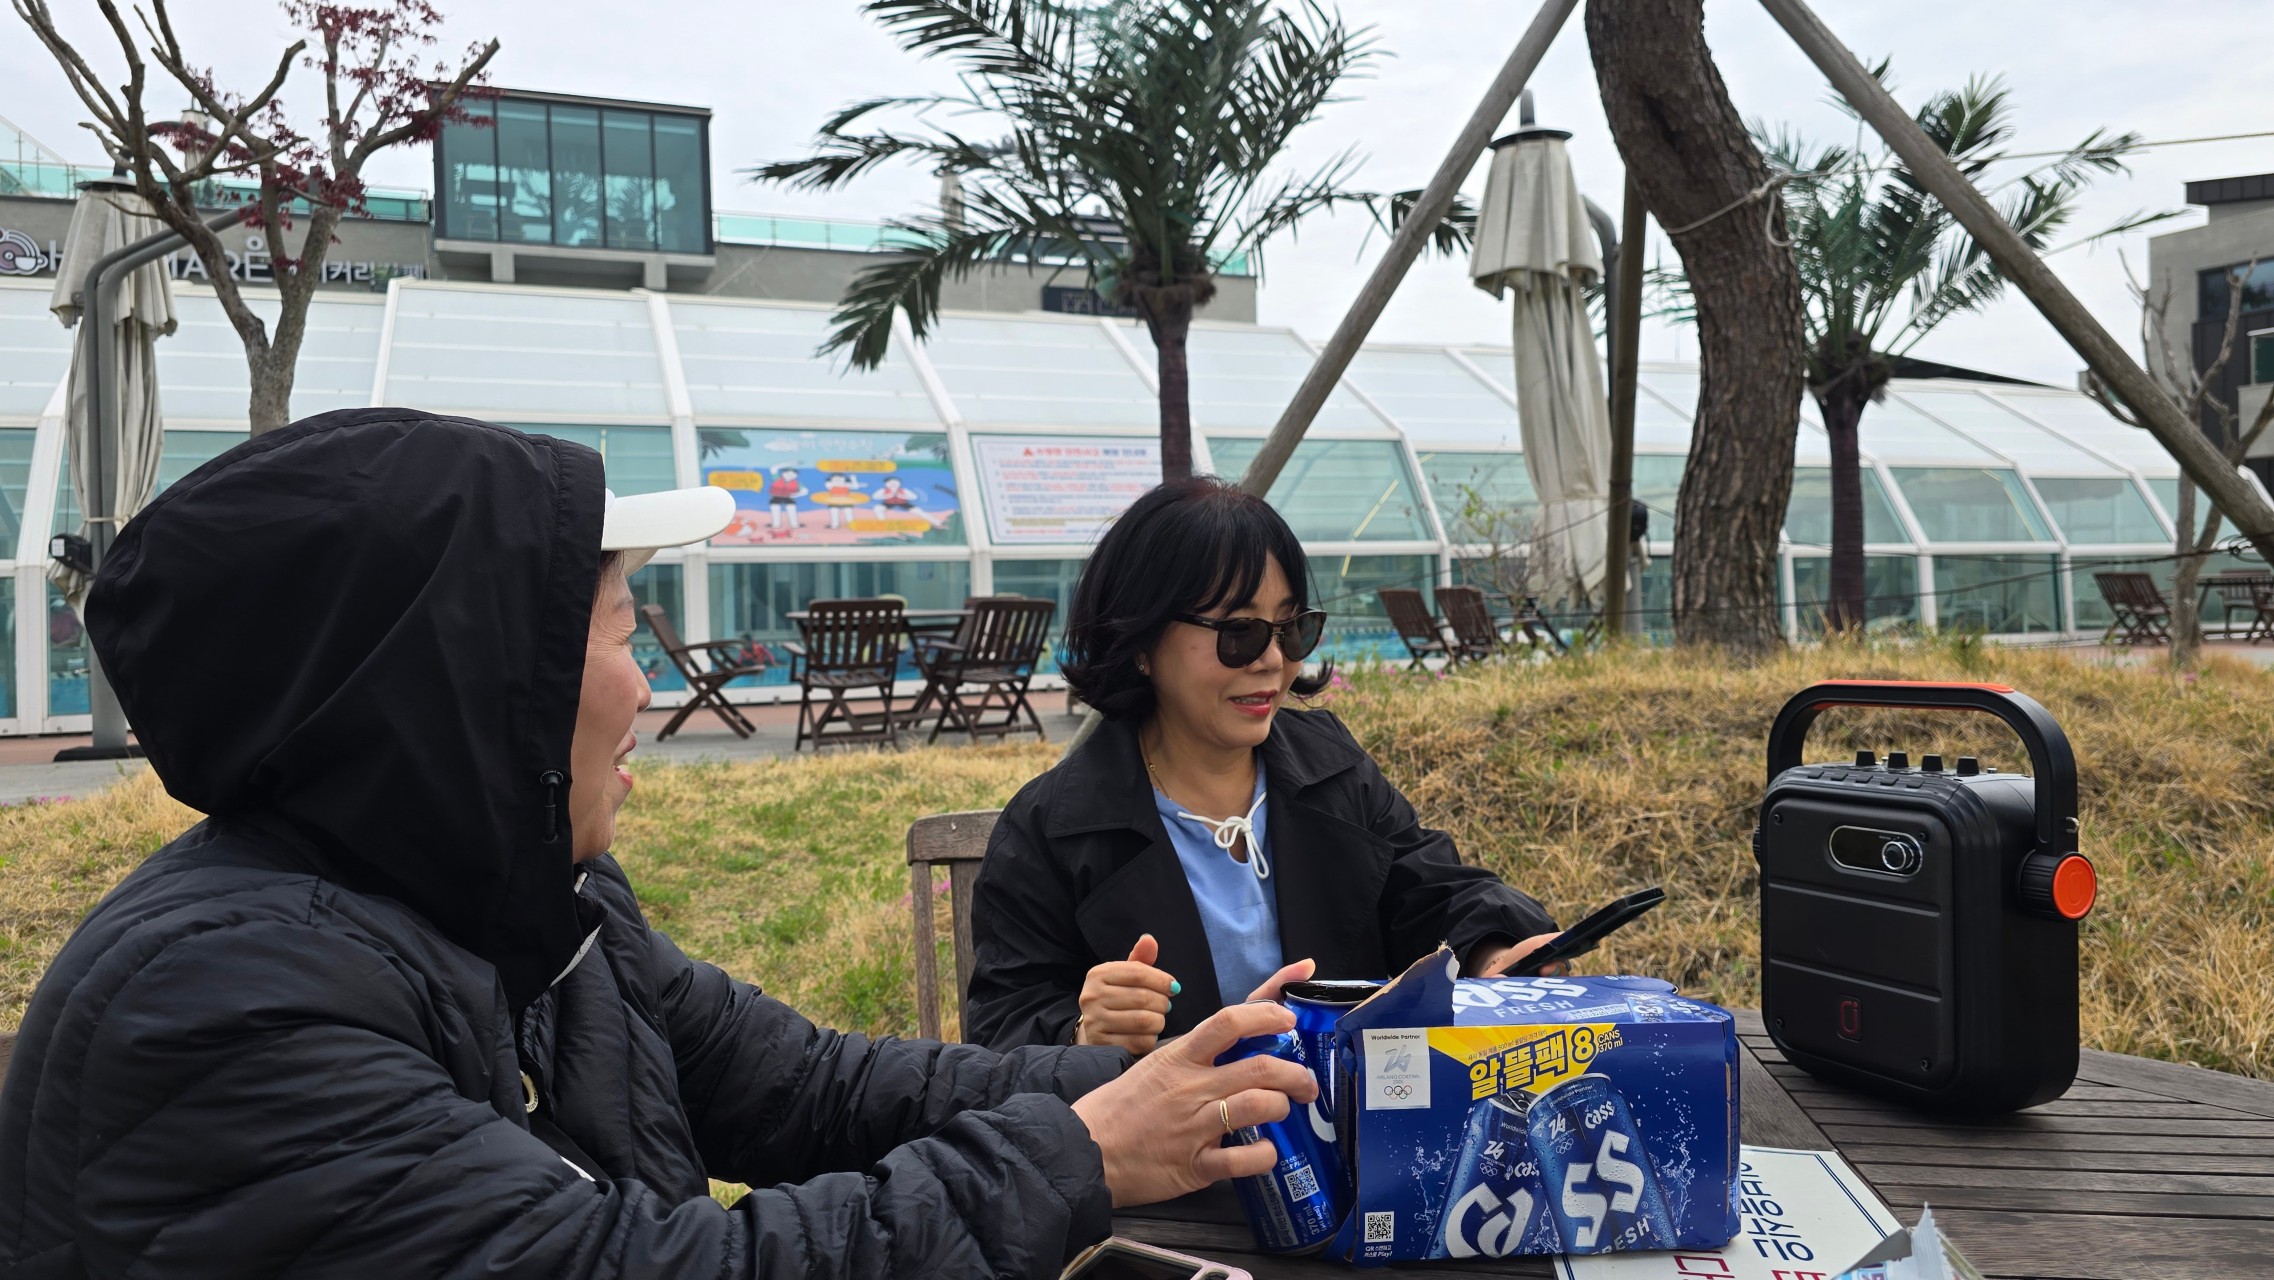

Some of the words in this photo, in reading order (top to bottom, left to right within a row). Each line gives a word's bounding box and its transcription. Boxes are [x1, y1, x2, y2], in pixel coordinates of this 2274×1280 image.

[1492, 1000, 1576, 1018] FRESH
[1371, 1033, 1400, 1041] Worldwide
[1400, 1033, 1420, 1041] Partner
[1598, 1029, 1620, 1044] CANS
[1572, 1028, 1596, 1062] 8
[1599, 1041, 1613, 1053] 370
[1469, 1032, 1567, 1101] 알뜰팩
[1501, 1121, 1528, 1135] Worldwide
[1307, 1217, 1321, 1236] 370
[1377, 1250, 1393, 1258] Play!
